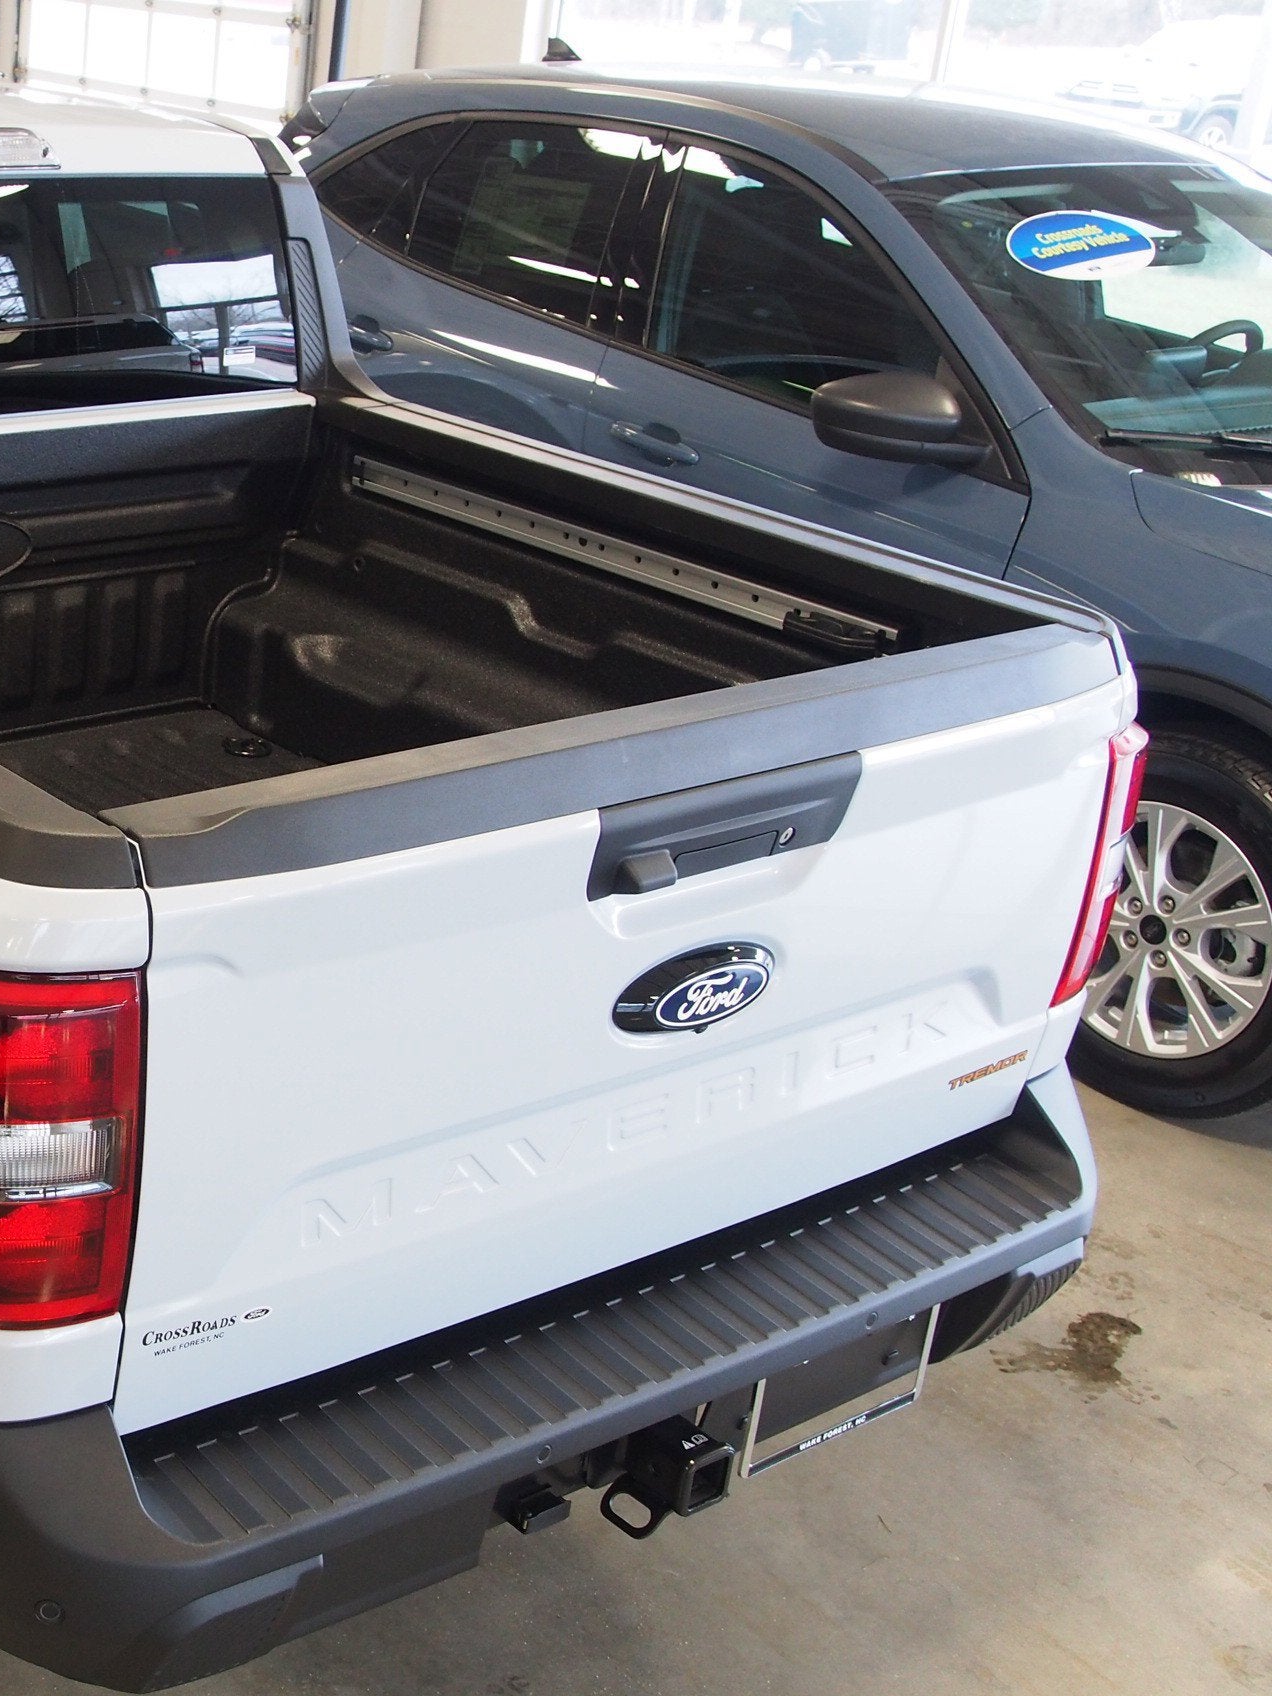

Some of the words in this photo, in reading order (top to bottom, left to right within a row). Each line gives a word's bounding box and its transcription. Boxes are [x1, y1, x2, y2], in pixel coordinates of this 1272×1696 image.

[1031, 237, 1090, 259] Courtesy
[1085, 231, 1130, 248] Vehicle
[1034, 223, 1103, 245] Crossroads
[677, 973, 749, 1021] Ford
[948, 1049, 1029, 1091] TREMOR
[301, 999, 948, 1248] MAVERICK
[153, 1345, 177, 1357] WAKE
[179, 1336, 212, 1350] FOREST,
[213, 1331, 225, 1340] NC
[799, 1434, 822, 1450] WAKE
[823, 1422, 854, 1440] FOREST,
[855, 1415, 867, 1426] NC
